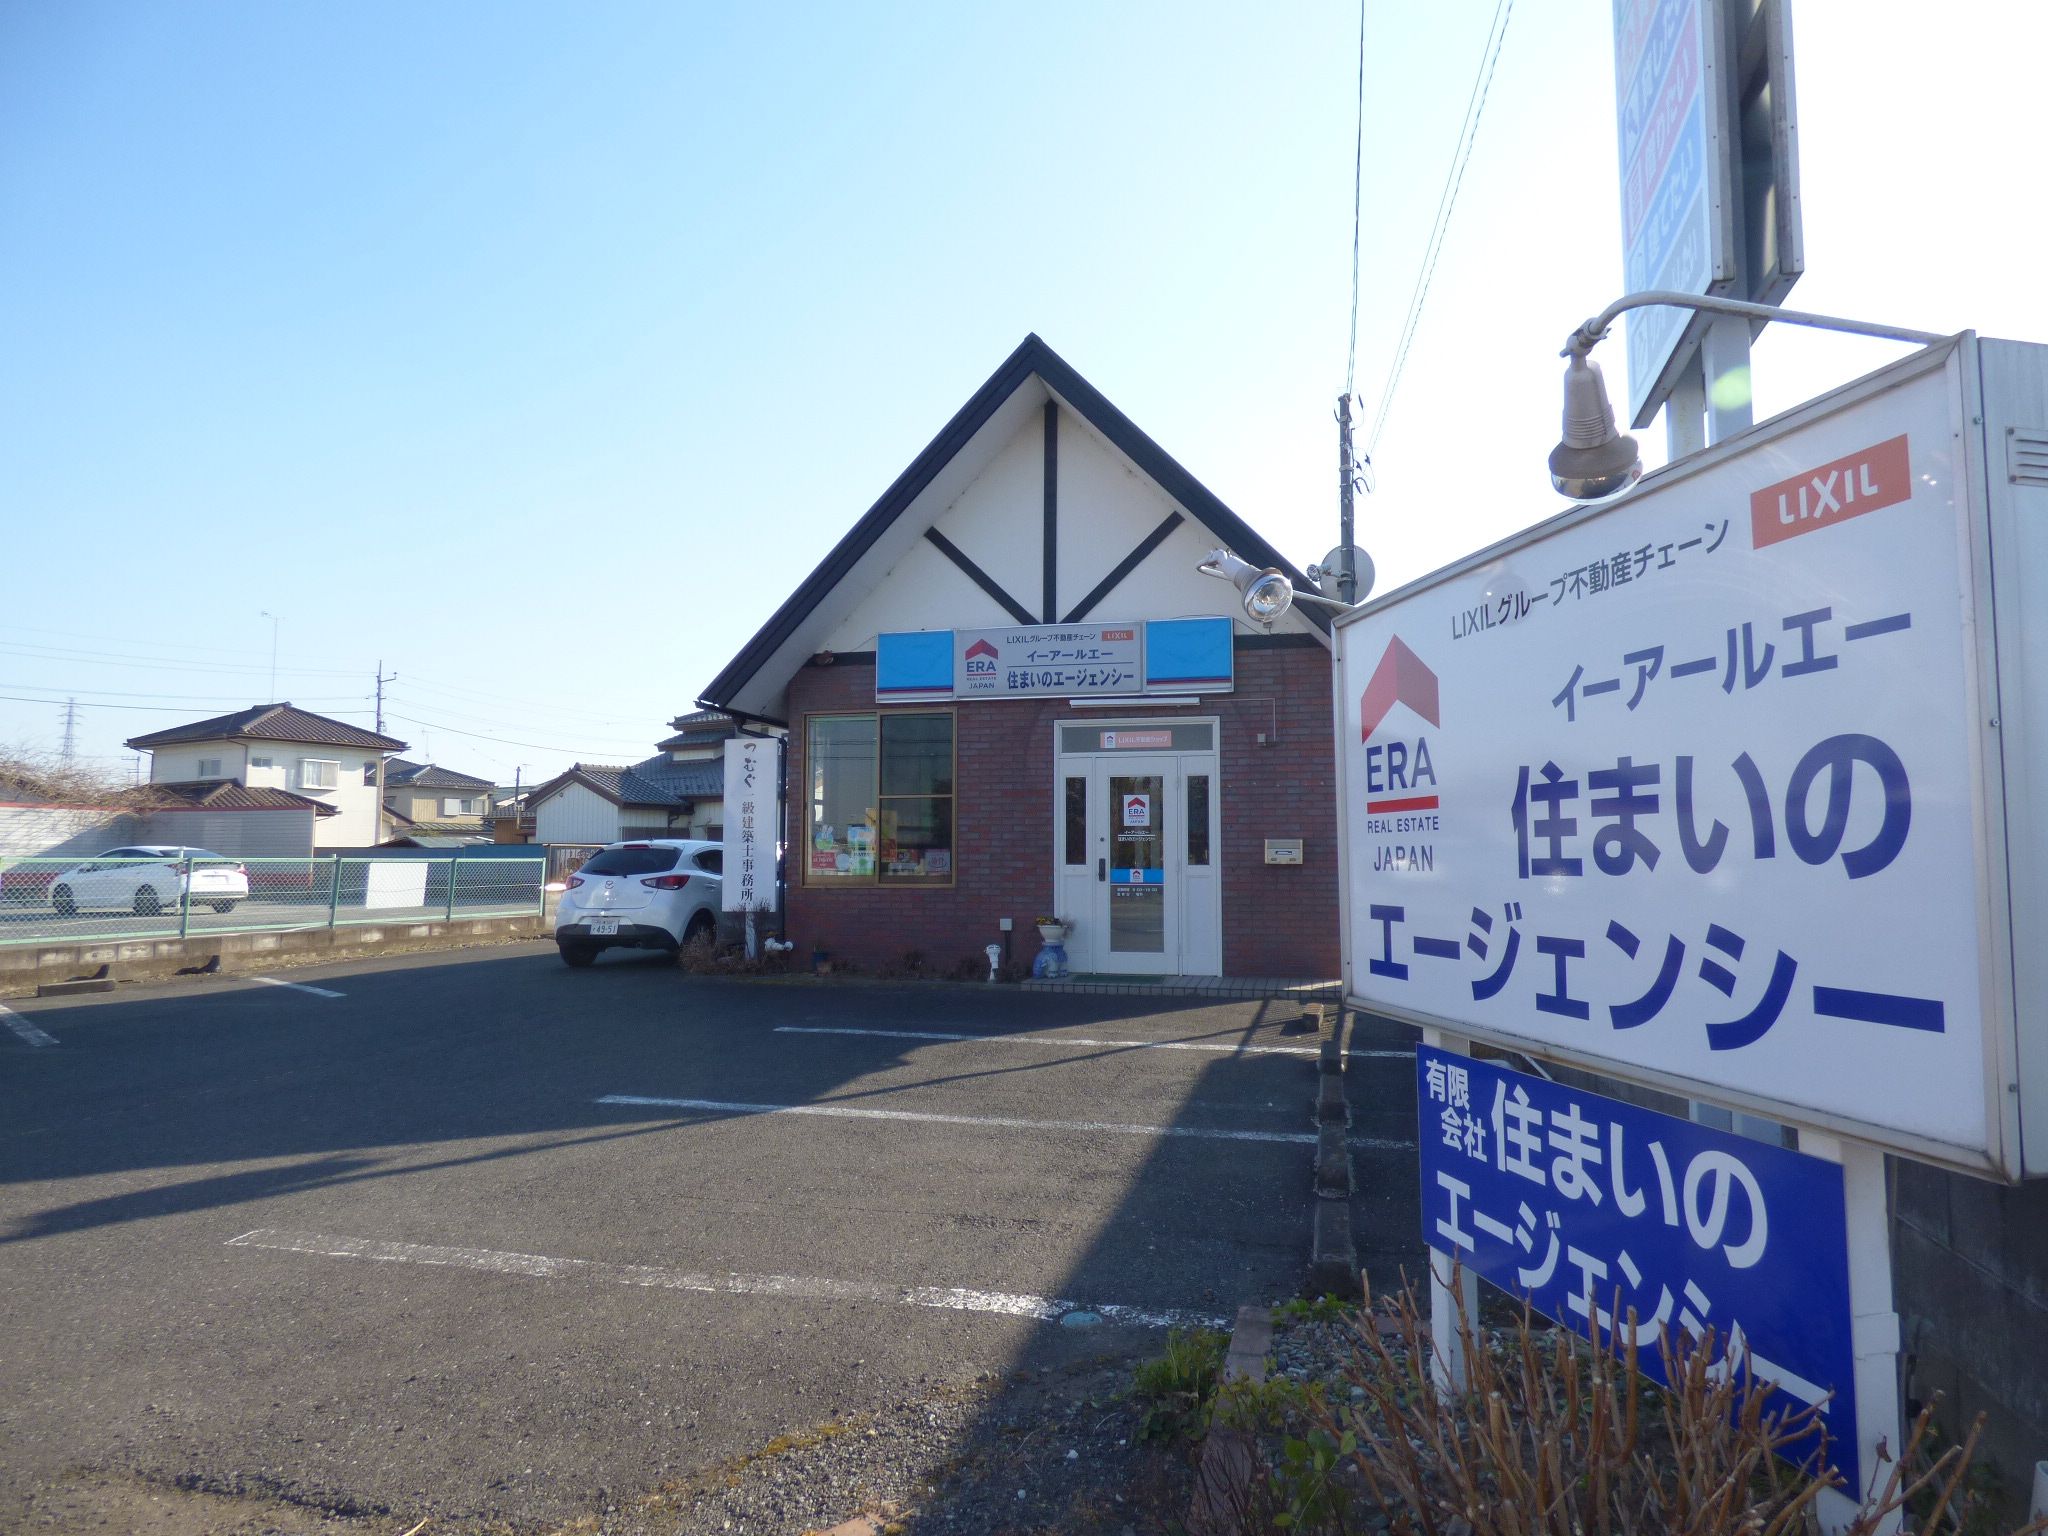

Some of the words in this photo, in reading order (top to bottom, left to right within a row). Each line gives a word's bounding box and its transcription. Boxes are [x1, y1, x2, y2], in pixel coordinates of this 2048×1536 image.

[1777, 463, 1878, 526] LIXIL
[1452, 519, 1730, 640] LIXILグループ不動産チェーン
[1006, 633, 1096, 644] LIXILグループ不動産チェーン
[1027, 648, 1114, 662] イーアールエー
[1107, 632, 1128, 640] LIXIL
[966, 661, 997, 673] ERA
[968, 682, 995, 690] JAPAN
[1006, 668, 1134, 690] 住まいのエージェンシー
[1551, 606, 1912, 723] イーアールエー
[1366, 736, 1437, 794] ERA
[1367, 818, 1393, 834] REAL
[1397, 815, 1440, 832] ESTATE
[1510, 732, 1912, 880] 住まいの
[1373, 844, 1433, 873] JAPAN
[1369, 901, 1946, 1051] エージェンシー
[1426, 1058, 1470, 1111] 有限
[1440, 1107, 1488, 1163] 会社
[1490, 1078, 1768, 1270] 住まいの
[1436, 1169, 1831, 1415] エージェンシー
